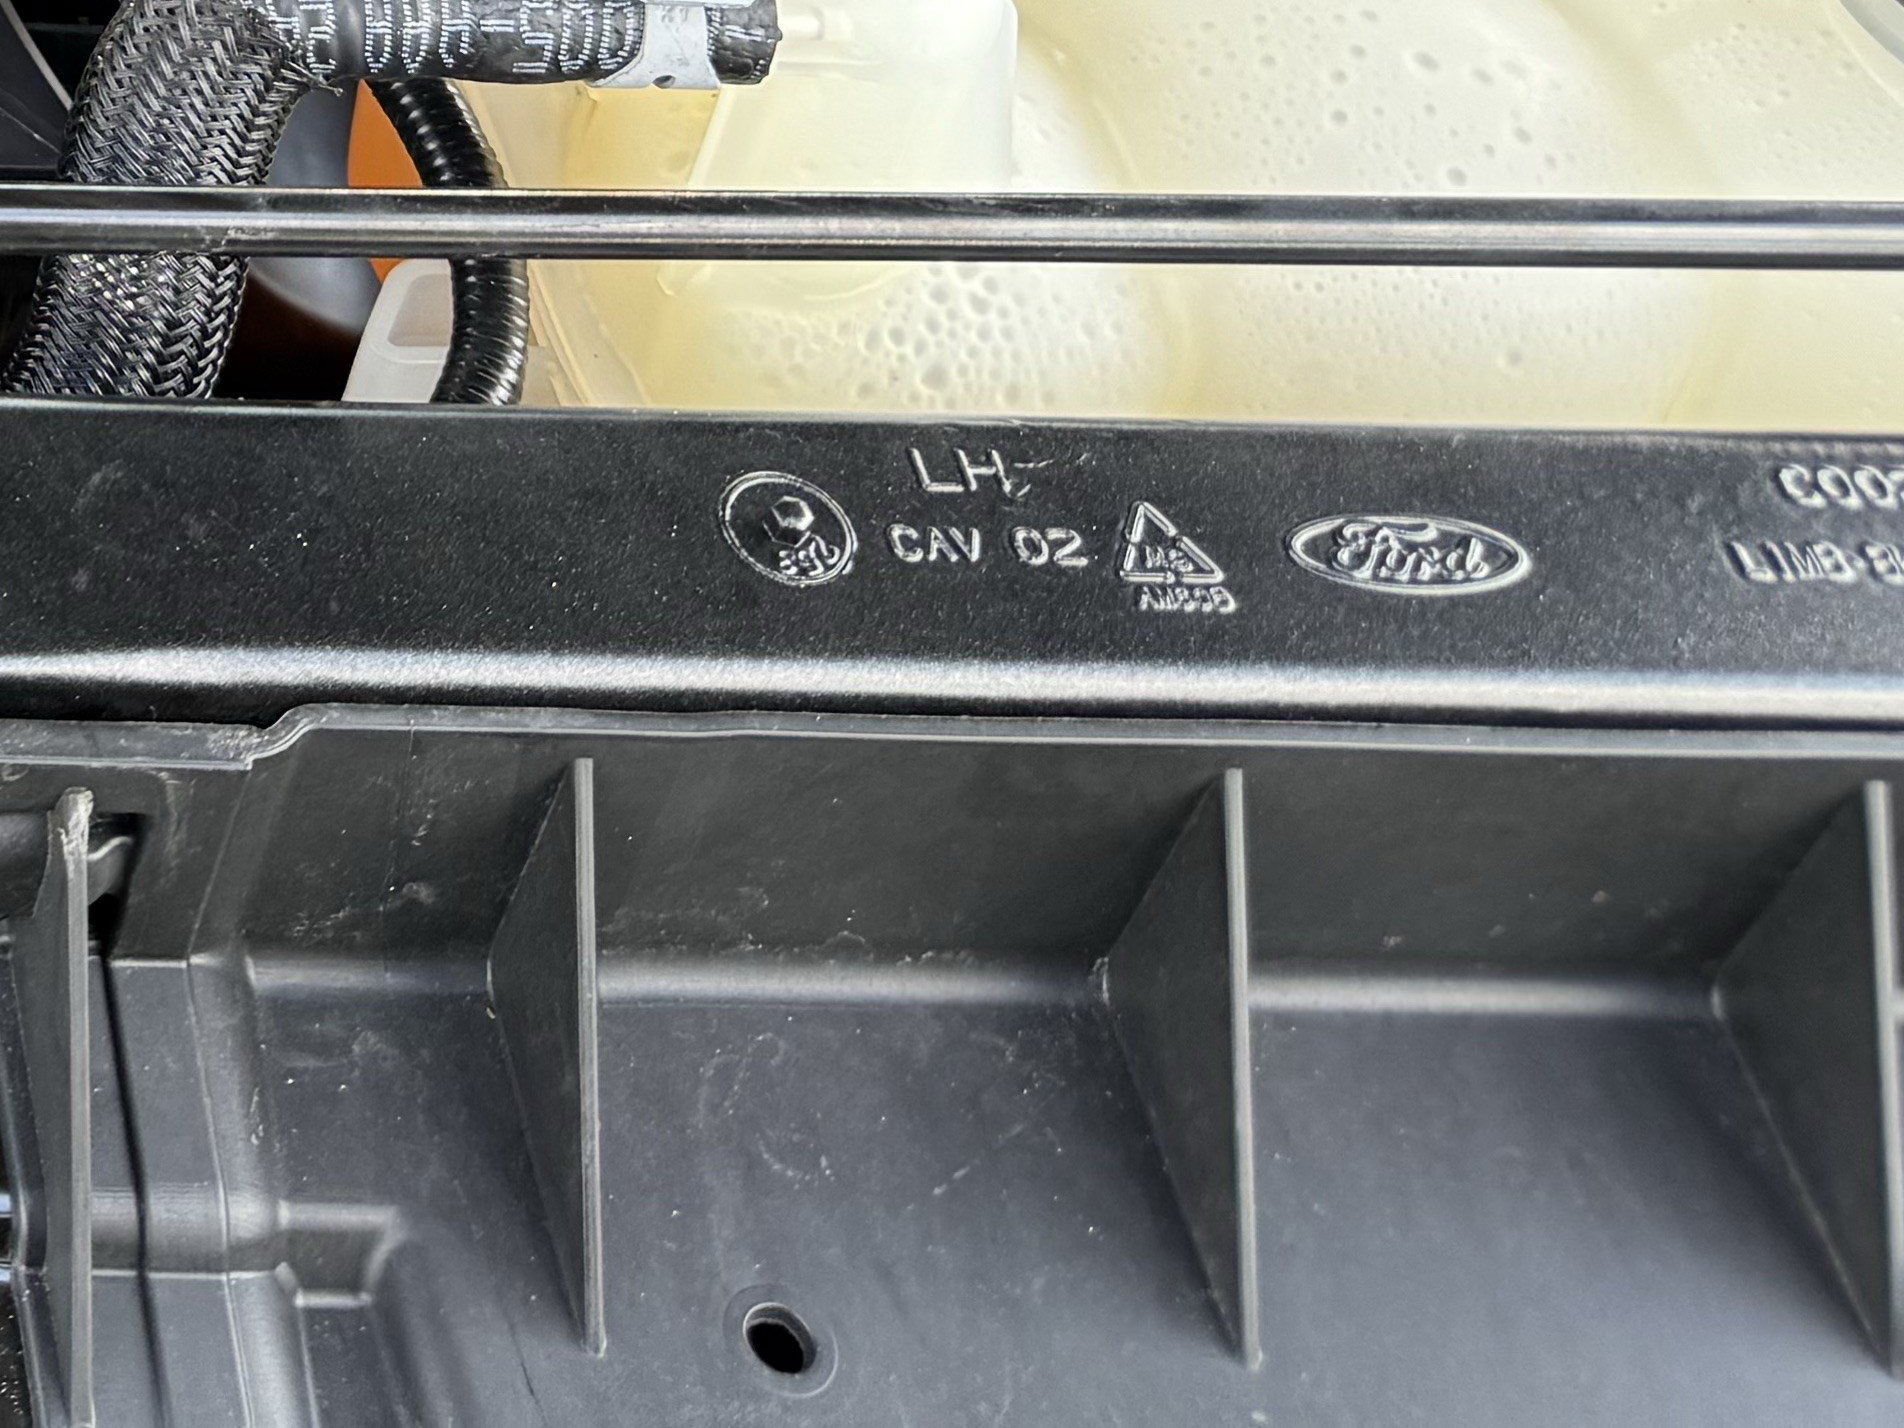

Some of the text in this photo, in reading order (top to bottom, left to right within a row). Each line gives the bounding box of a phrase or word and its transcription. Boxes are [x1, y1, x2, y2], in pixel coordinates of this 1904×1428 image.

[1778, 463, 1904, 511] C00
[888, 522, 981, 564] CAV
[1011, 525, 1089, 566] 02
